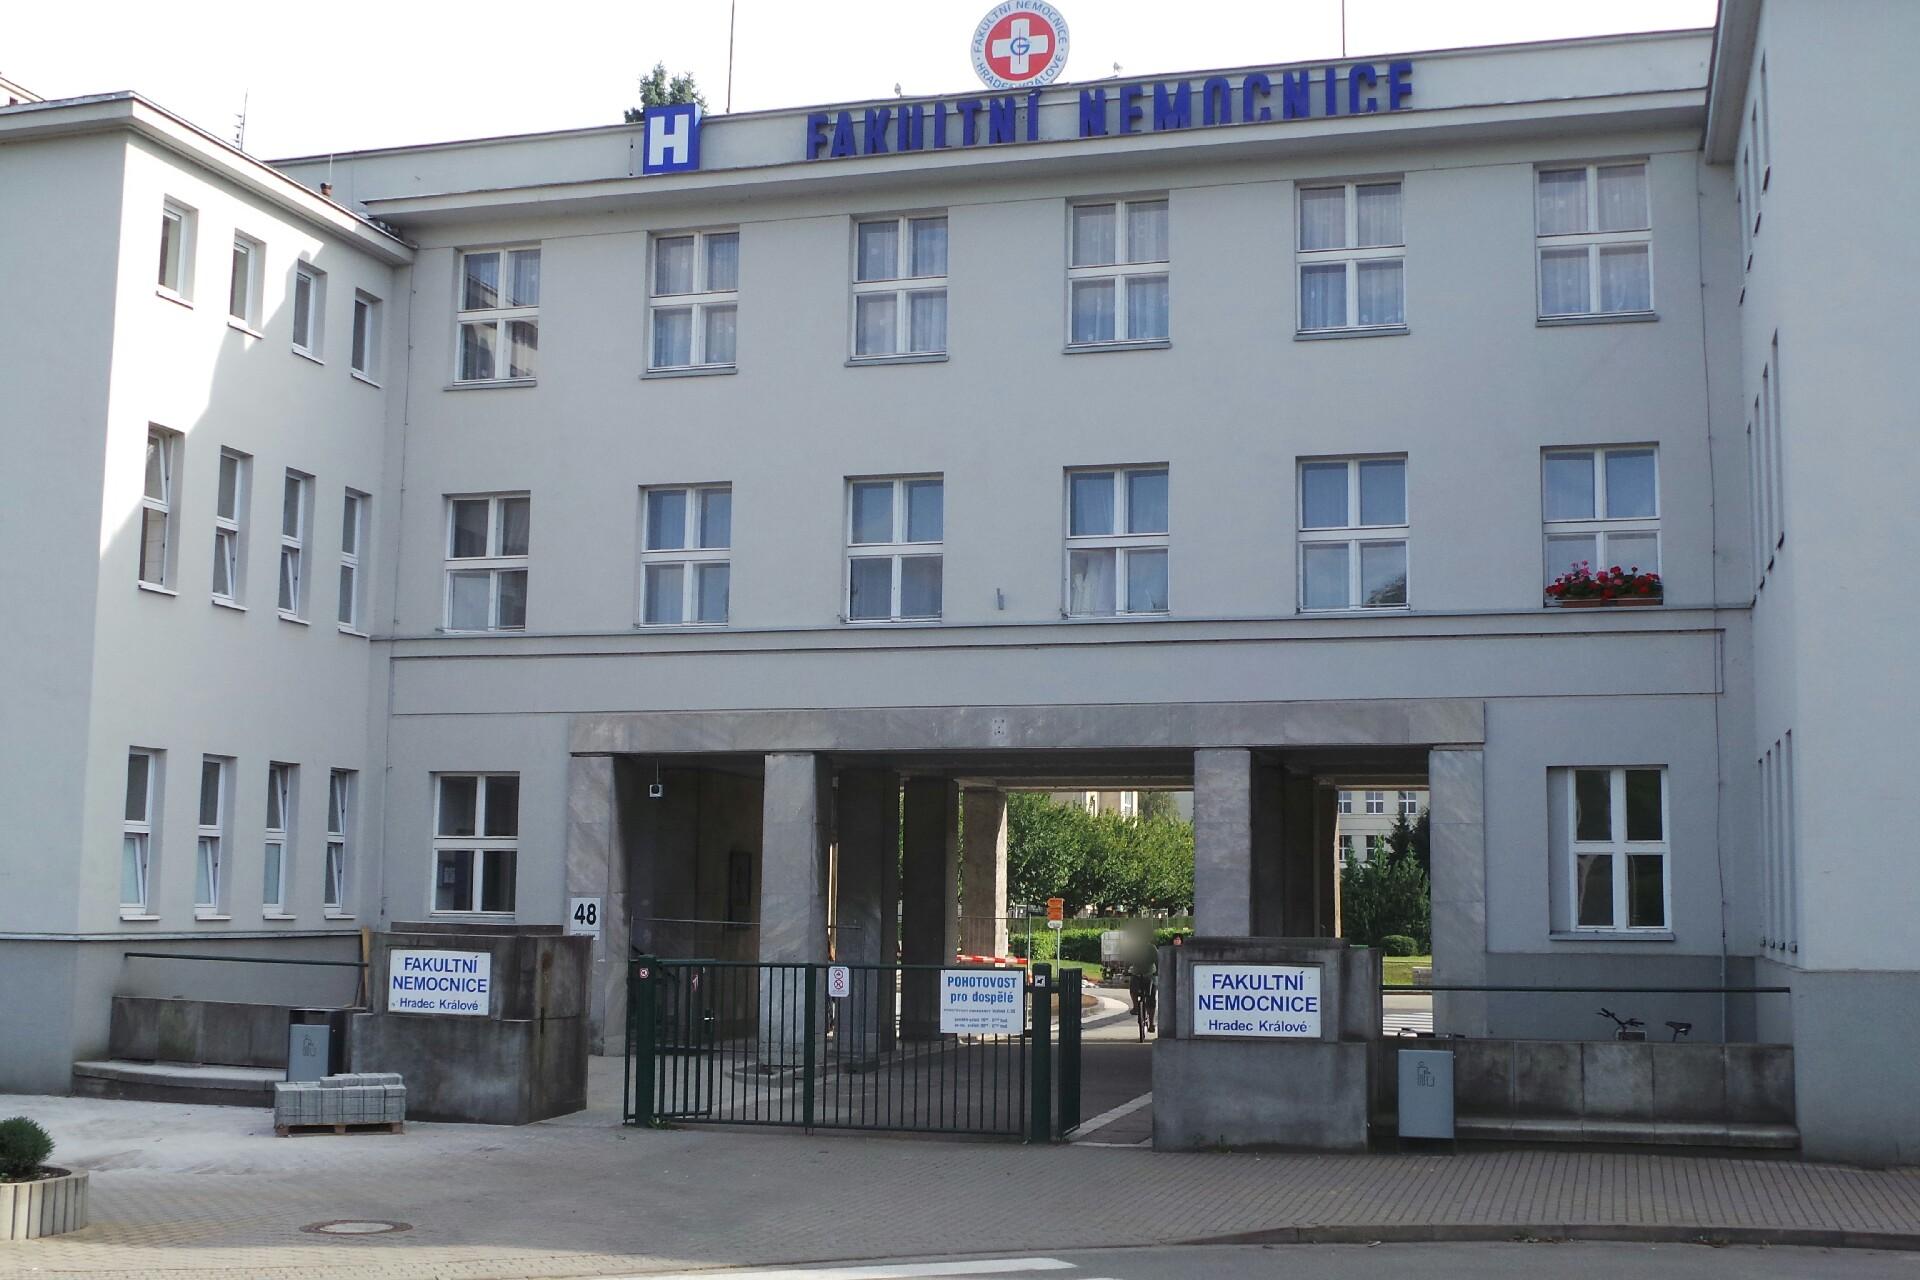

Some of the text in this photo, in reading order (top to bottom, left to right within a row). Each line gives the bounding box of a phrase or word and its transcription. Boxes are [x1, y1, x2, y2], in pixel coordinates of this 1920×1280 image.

[806, 59, 1413, 160] FAKULTNÍ NEMOCNICE
[649, 114, 690, 166] H
[573, 903, 597, 925] 48
[404, 955, 479, 974] FAKULTNÍ
[392, 975, 487, 993] NEMOCNICE
[947, 976, 1017, 988] POHOTOVOST
[1212, 970, 1304, 991] FAKULTNÍ
[400, 997, 479, 1011] Hradec Králové
[950, 991, 1014, 1005] pro dospělé
[1198, 994, 1318, 1013] NEMOCNICE
[1208, 1019, 1307, 1032] Hradec Králové
